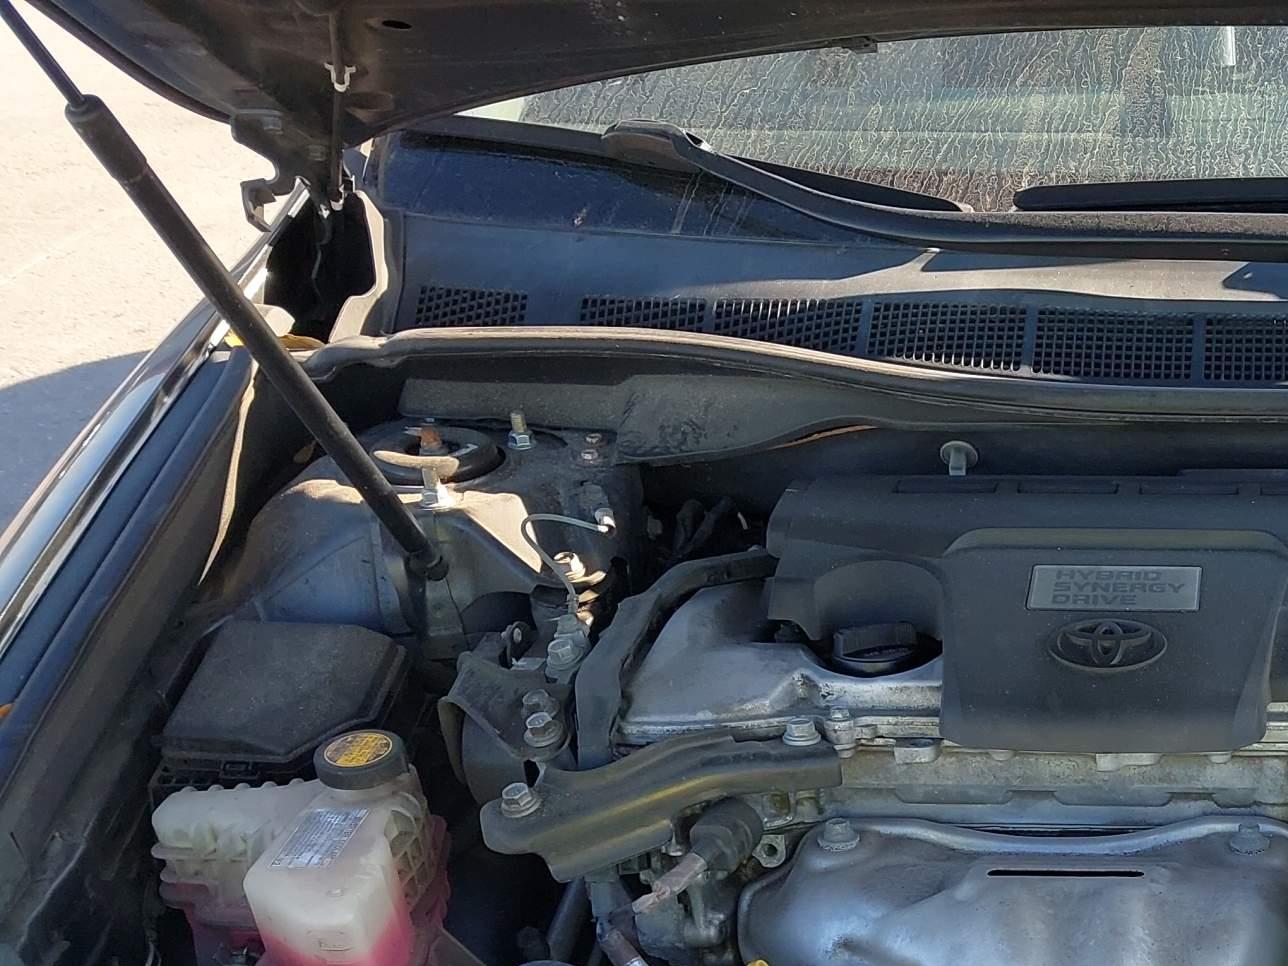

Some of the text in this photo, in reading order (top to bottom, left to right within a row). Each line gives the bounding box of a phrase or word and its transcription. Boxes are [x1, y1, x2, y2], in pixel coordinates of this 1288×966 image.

[1056, 570, 1162, 581] HYBRID
[1053, 582, 1185, 593] SYNERGY
[1052, 595, 1137, 605] DRIVE
